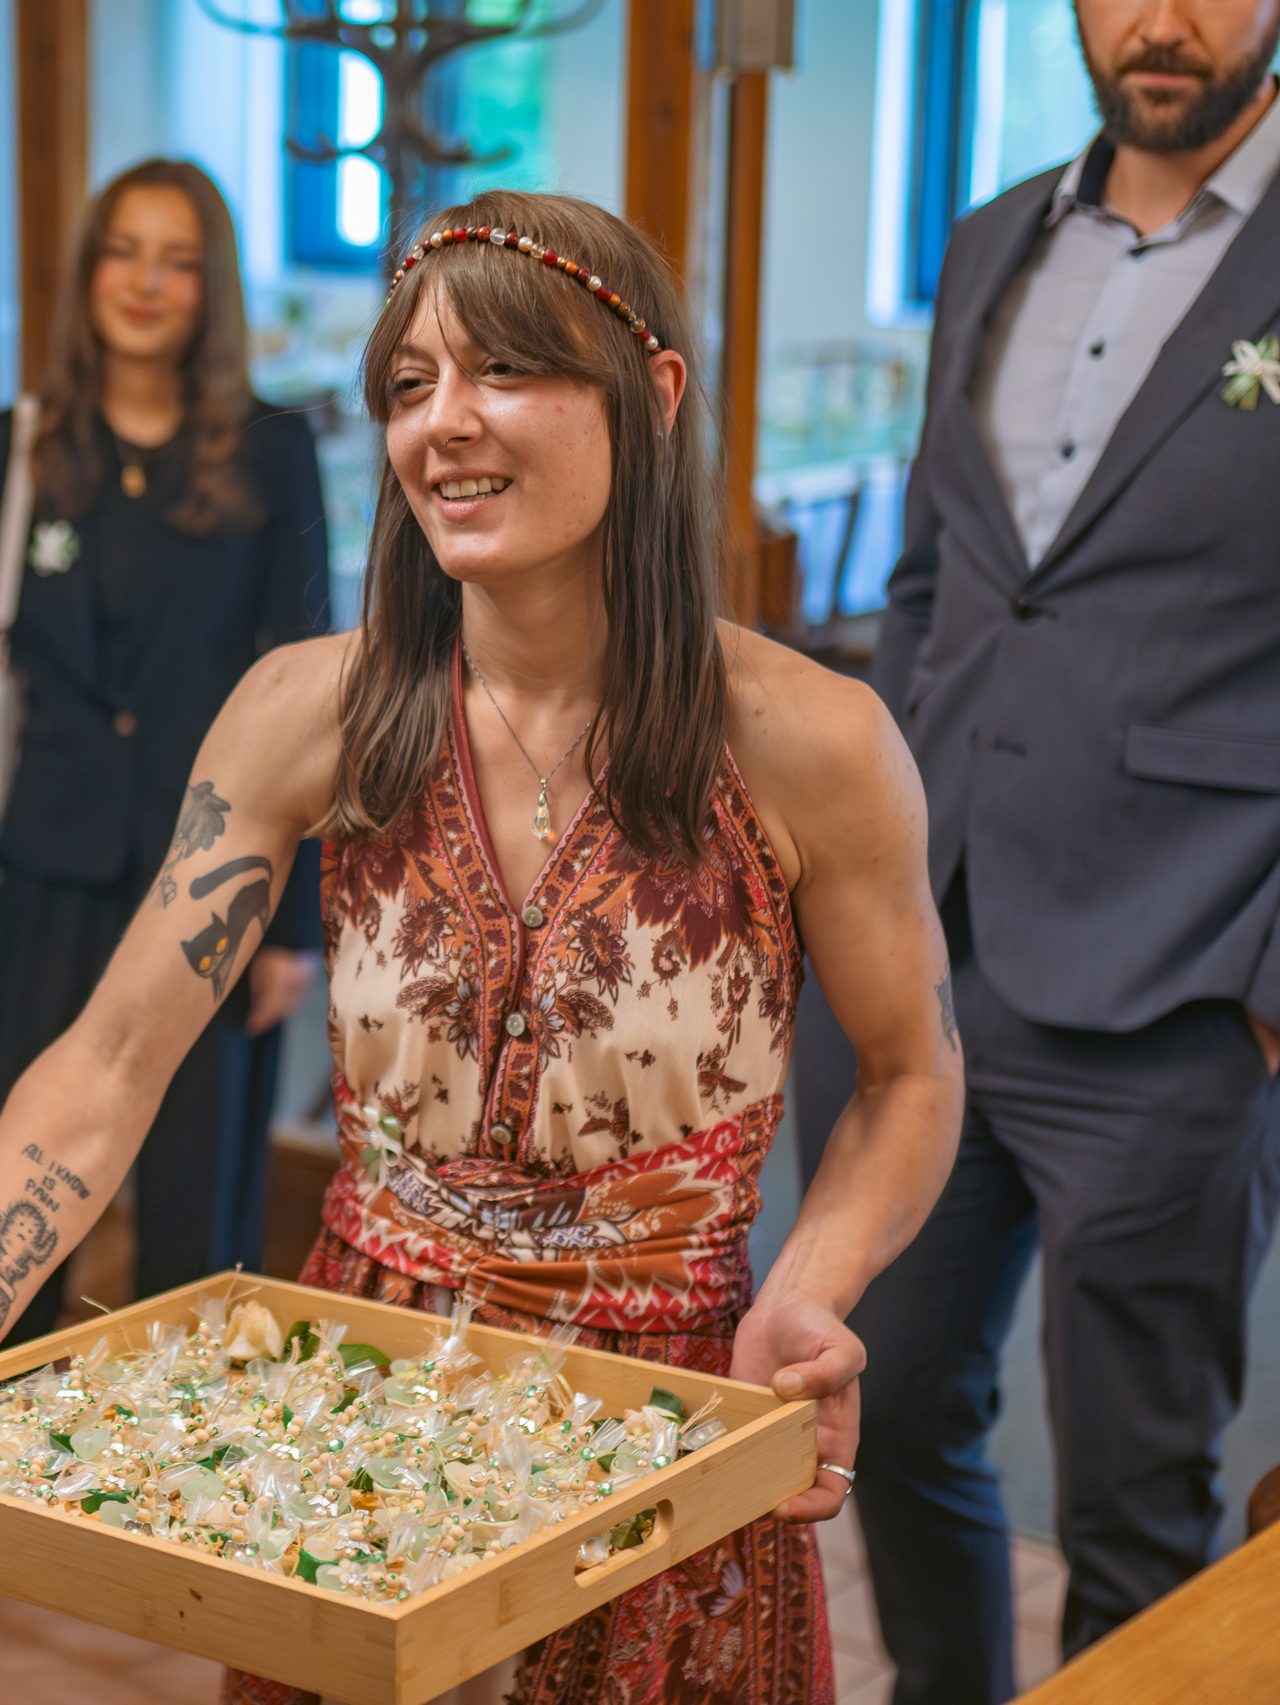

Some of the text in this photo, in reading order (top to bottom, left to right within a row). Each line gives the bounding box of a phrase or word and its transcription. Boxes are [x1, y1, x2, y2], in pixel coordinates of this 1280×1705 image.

[21, 1143, 44, 1166] ALL
[55, 1164, 91, 1201] KNOW
[41, 1175, 57, 1192] IS
[24, 1178, 61, 1213] PAIN
